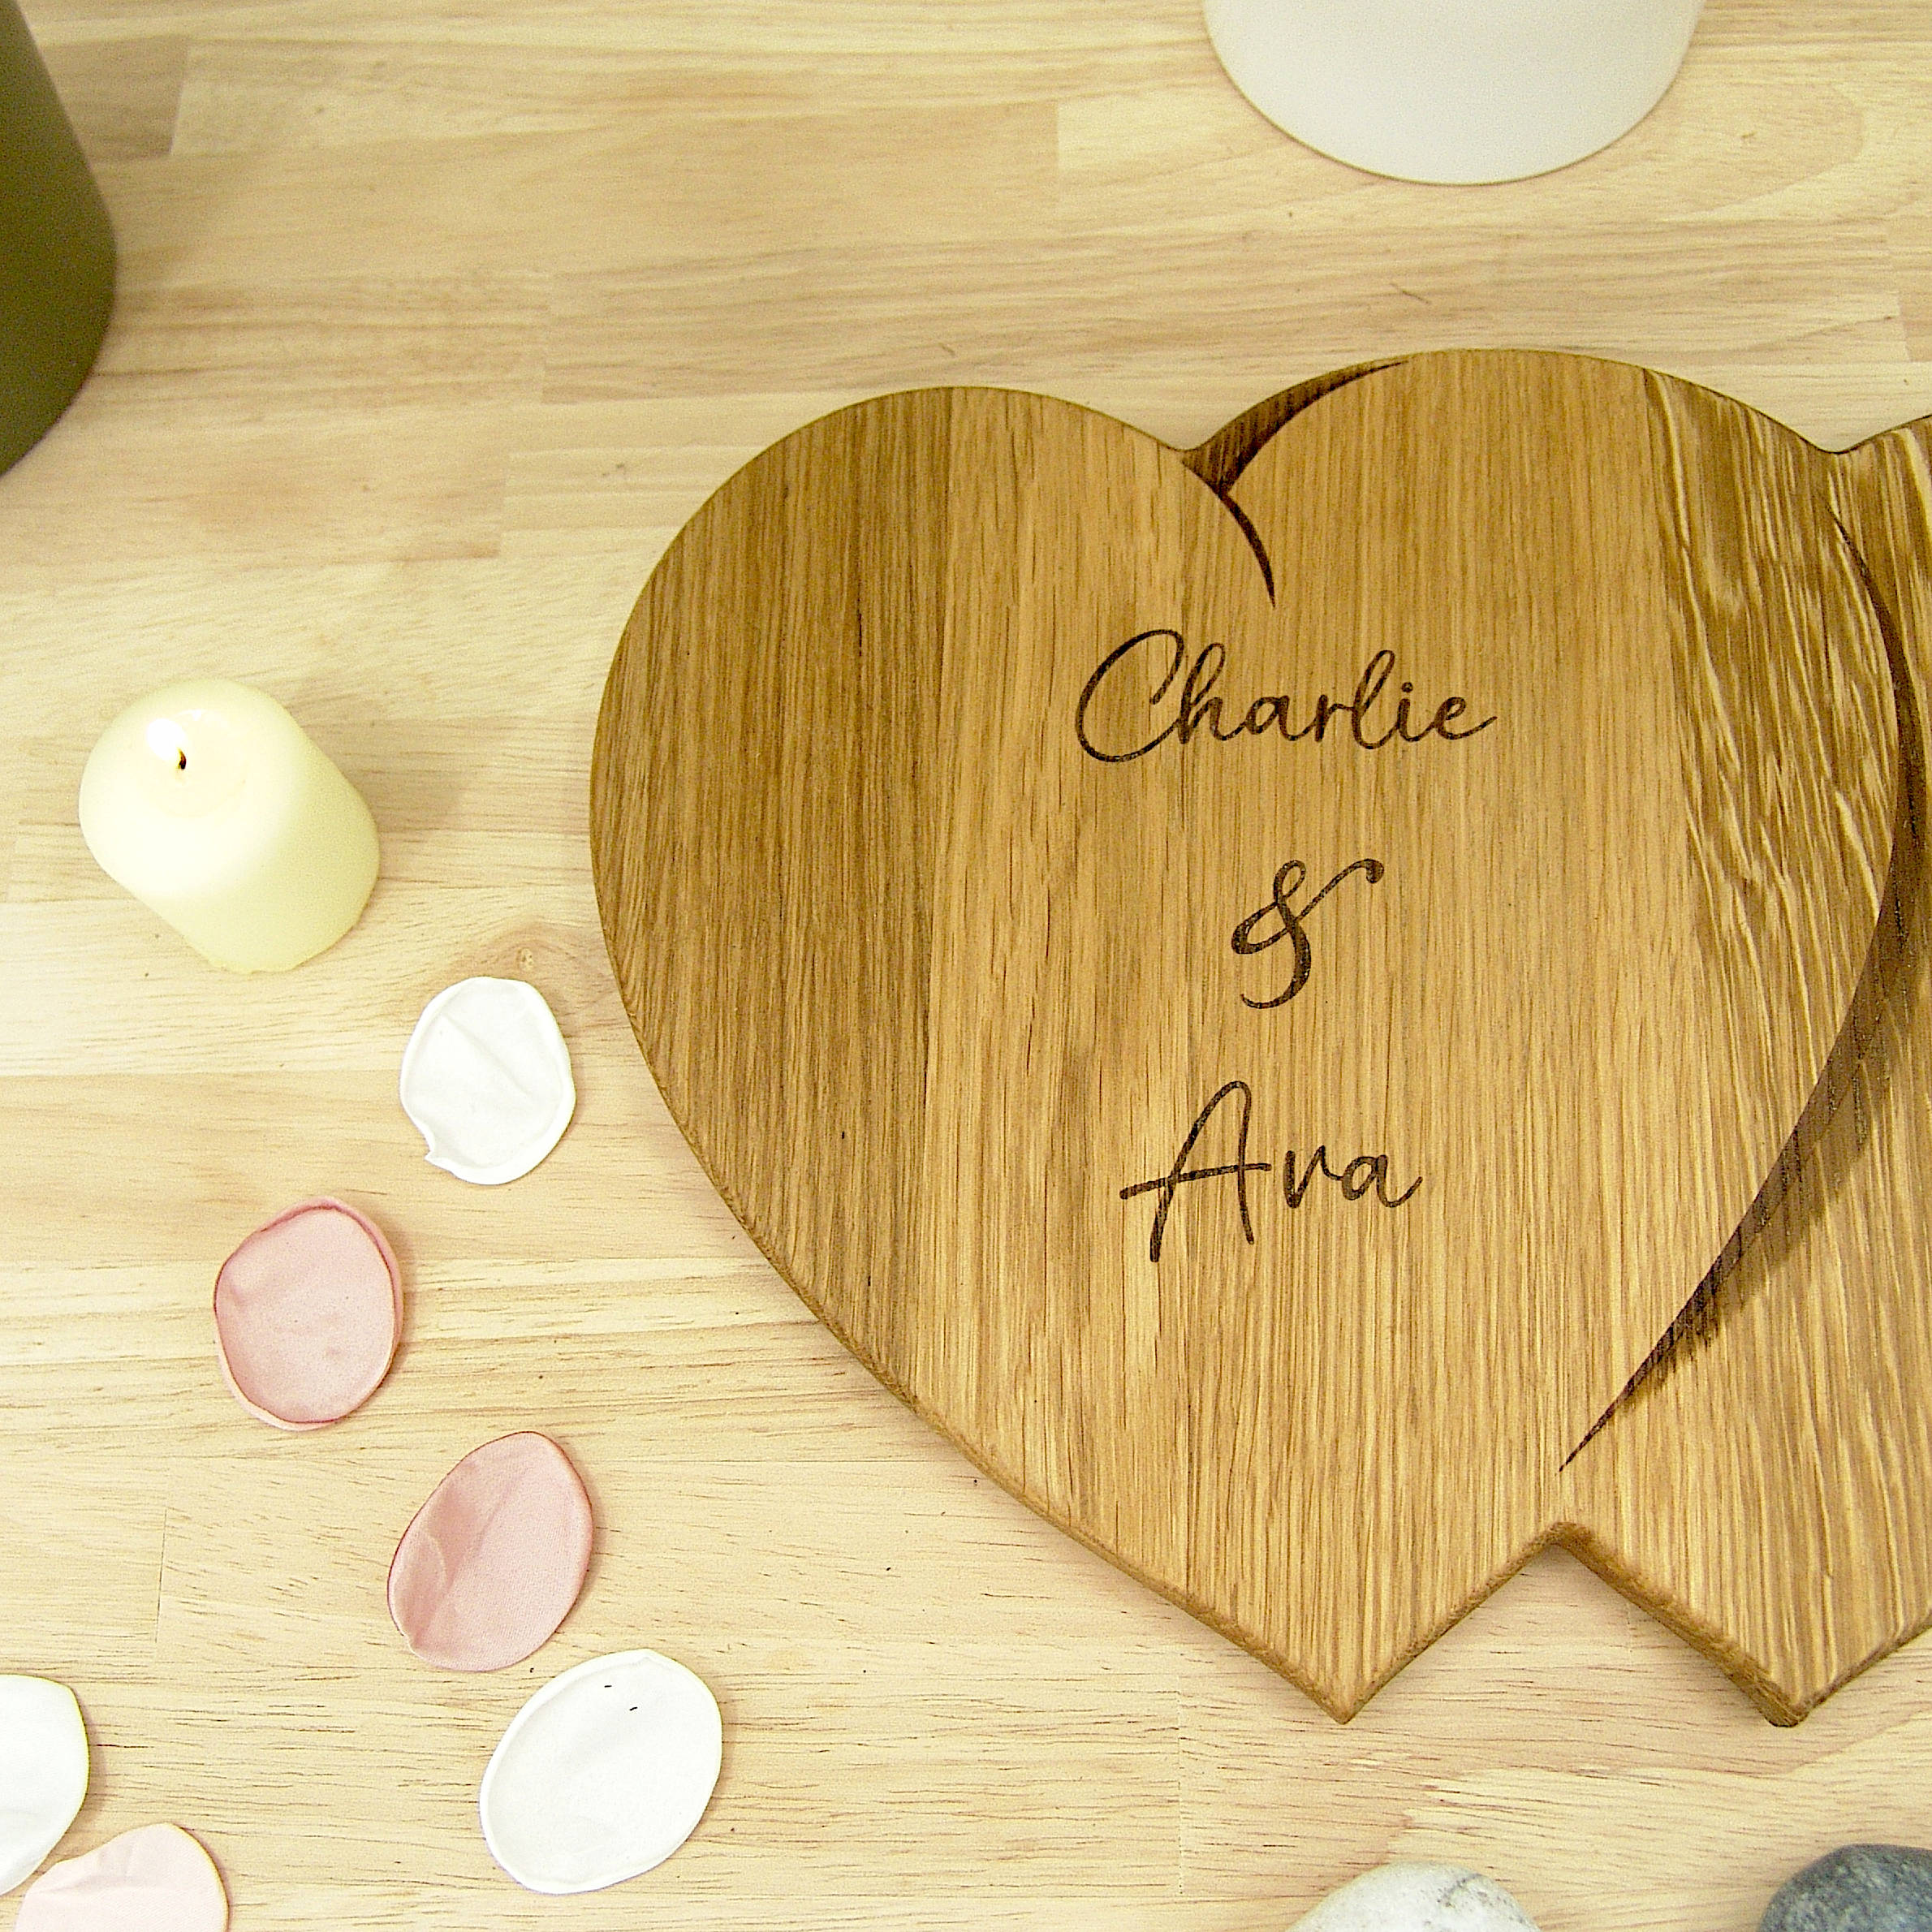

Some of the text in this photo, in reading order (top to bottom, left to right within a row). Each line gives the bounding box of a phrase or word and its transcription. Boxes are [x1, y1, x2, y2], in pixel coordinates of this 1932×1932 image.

[1076, 629, 1498, 762] Charlie
[1231, 859, 1385, 1009] &
[1119, 1080, 1422, 1262] Ava
